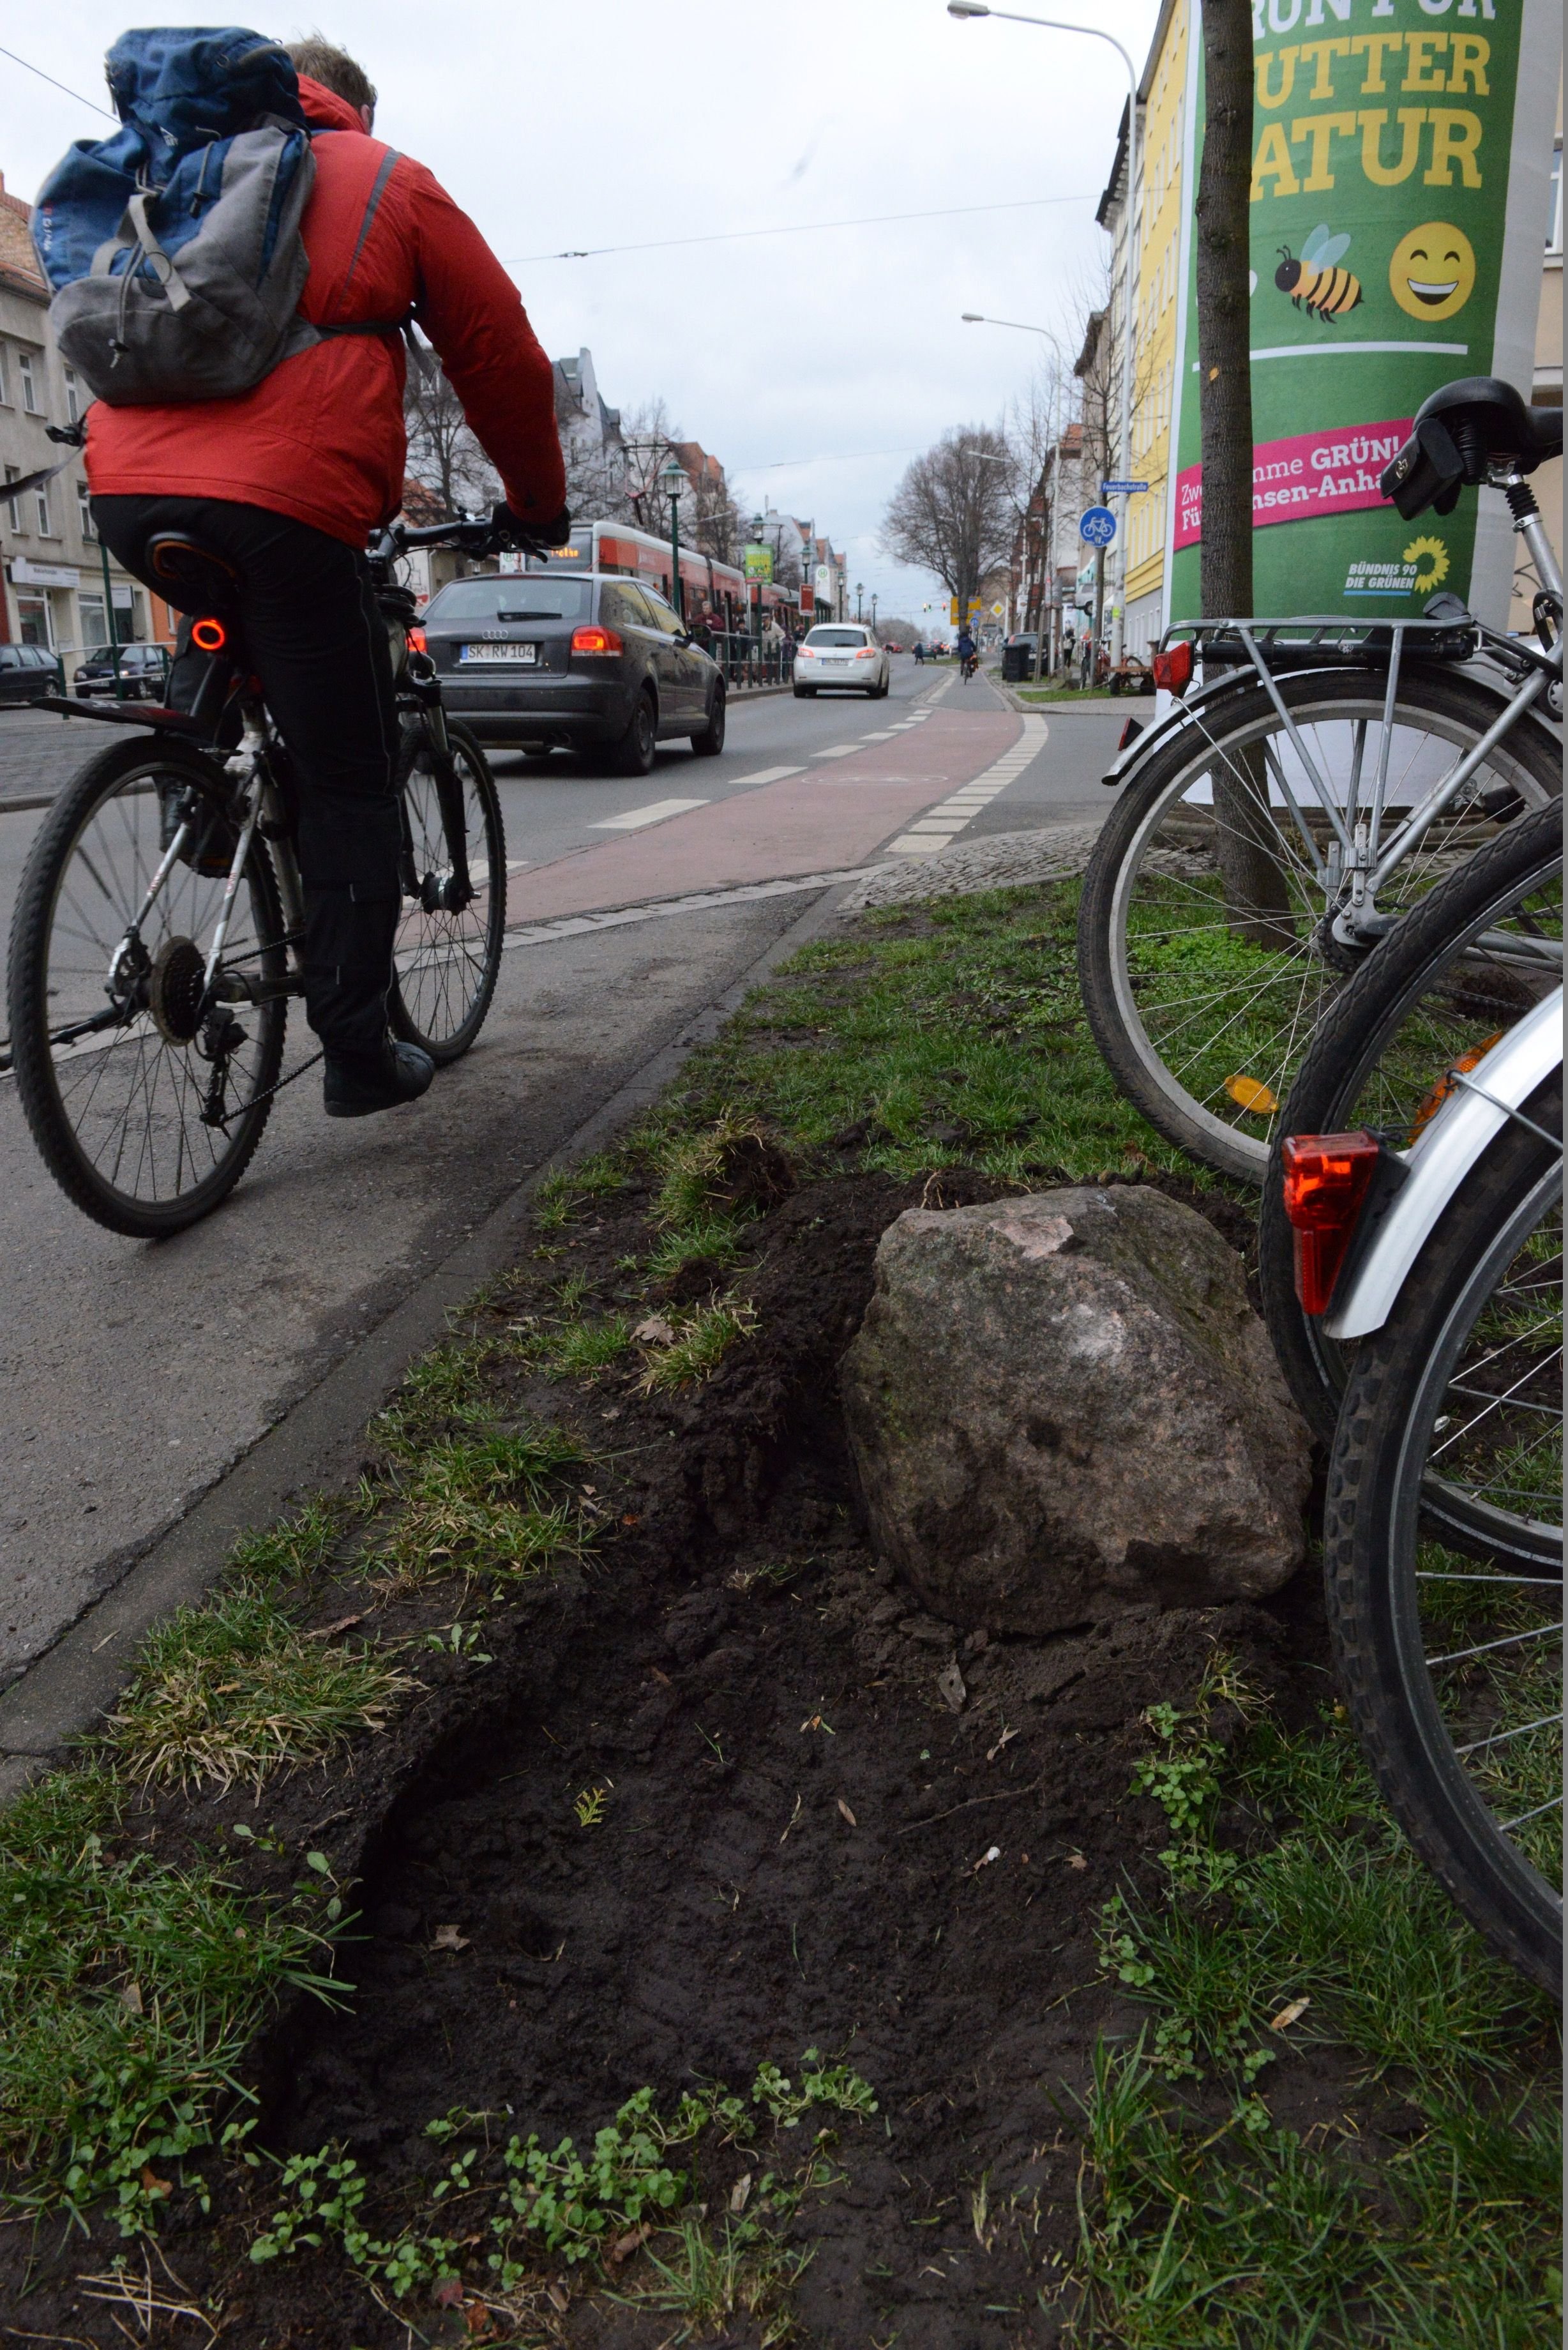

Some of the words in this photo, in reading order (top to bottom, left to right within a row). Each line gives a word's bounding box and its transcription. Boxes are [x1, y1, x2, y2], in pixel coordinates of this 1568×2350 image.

[1253, 31, 1491, 110] UTTER
[1249, 107, 1482, 203] ATUR
[1311, 436, 1399, 470] GRÜN!
[1103, 482, 1148, 491] Feuerbachstraße
[1182, 506, 1202, 531] Fü
[1348, 561, 1400, 575] BÜNDNIS
[1402, 564, 1417, 575] 90
[1345, 577, 1366, 588] DIE
[1368, 575, 1415, 589] GRÜNEN
[469, 646, 484, 658] SK
[492, 646, 508, 658] RW
[511, 645, 533, 658] 104
